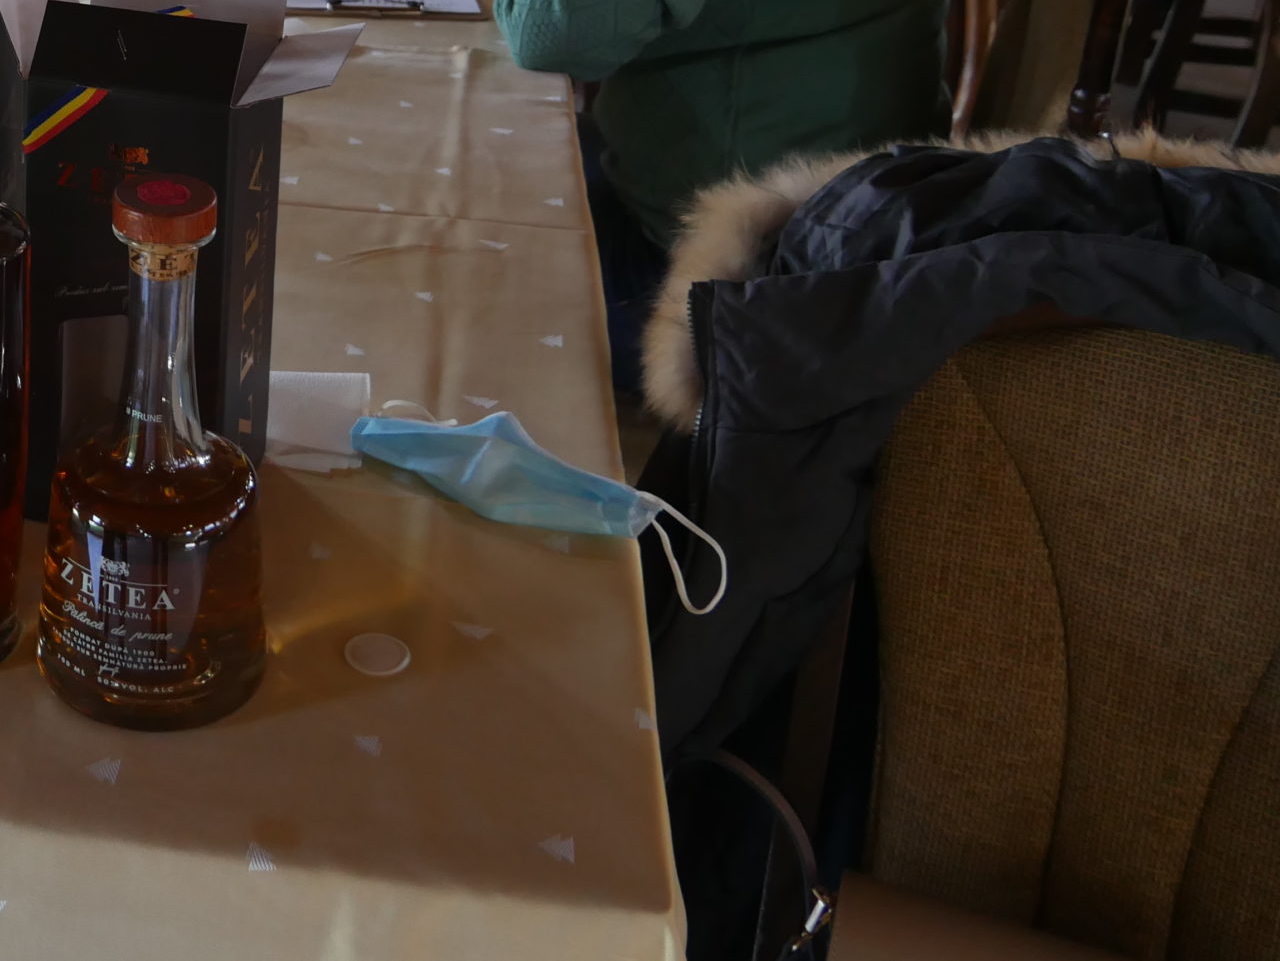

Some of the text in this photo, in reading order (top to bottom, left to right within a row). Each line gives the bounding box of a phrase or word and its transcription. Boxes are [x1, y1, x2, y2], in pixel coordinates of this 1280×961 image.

[131, 409, 163, 423] PRUNE
[60, 557, 177, 611] ZETEA
[76, 592, 152, 621] TRANSILVANIA
[110, 624, 127, 637] de
[128, 632, 173, 642] prune
